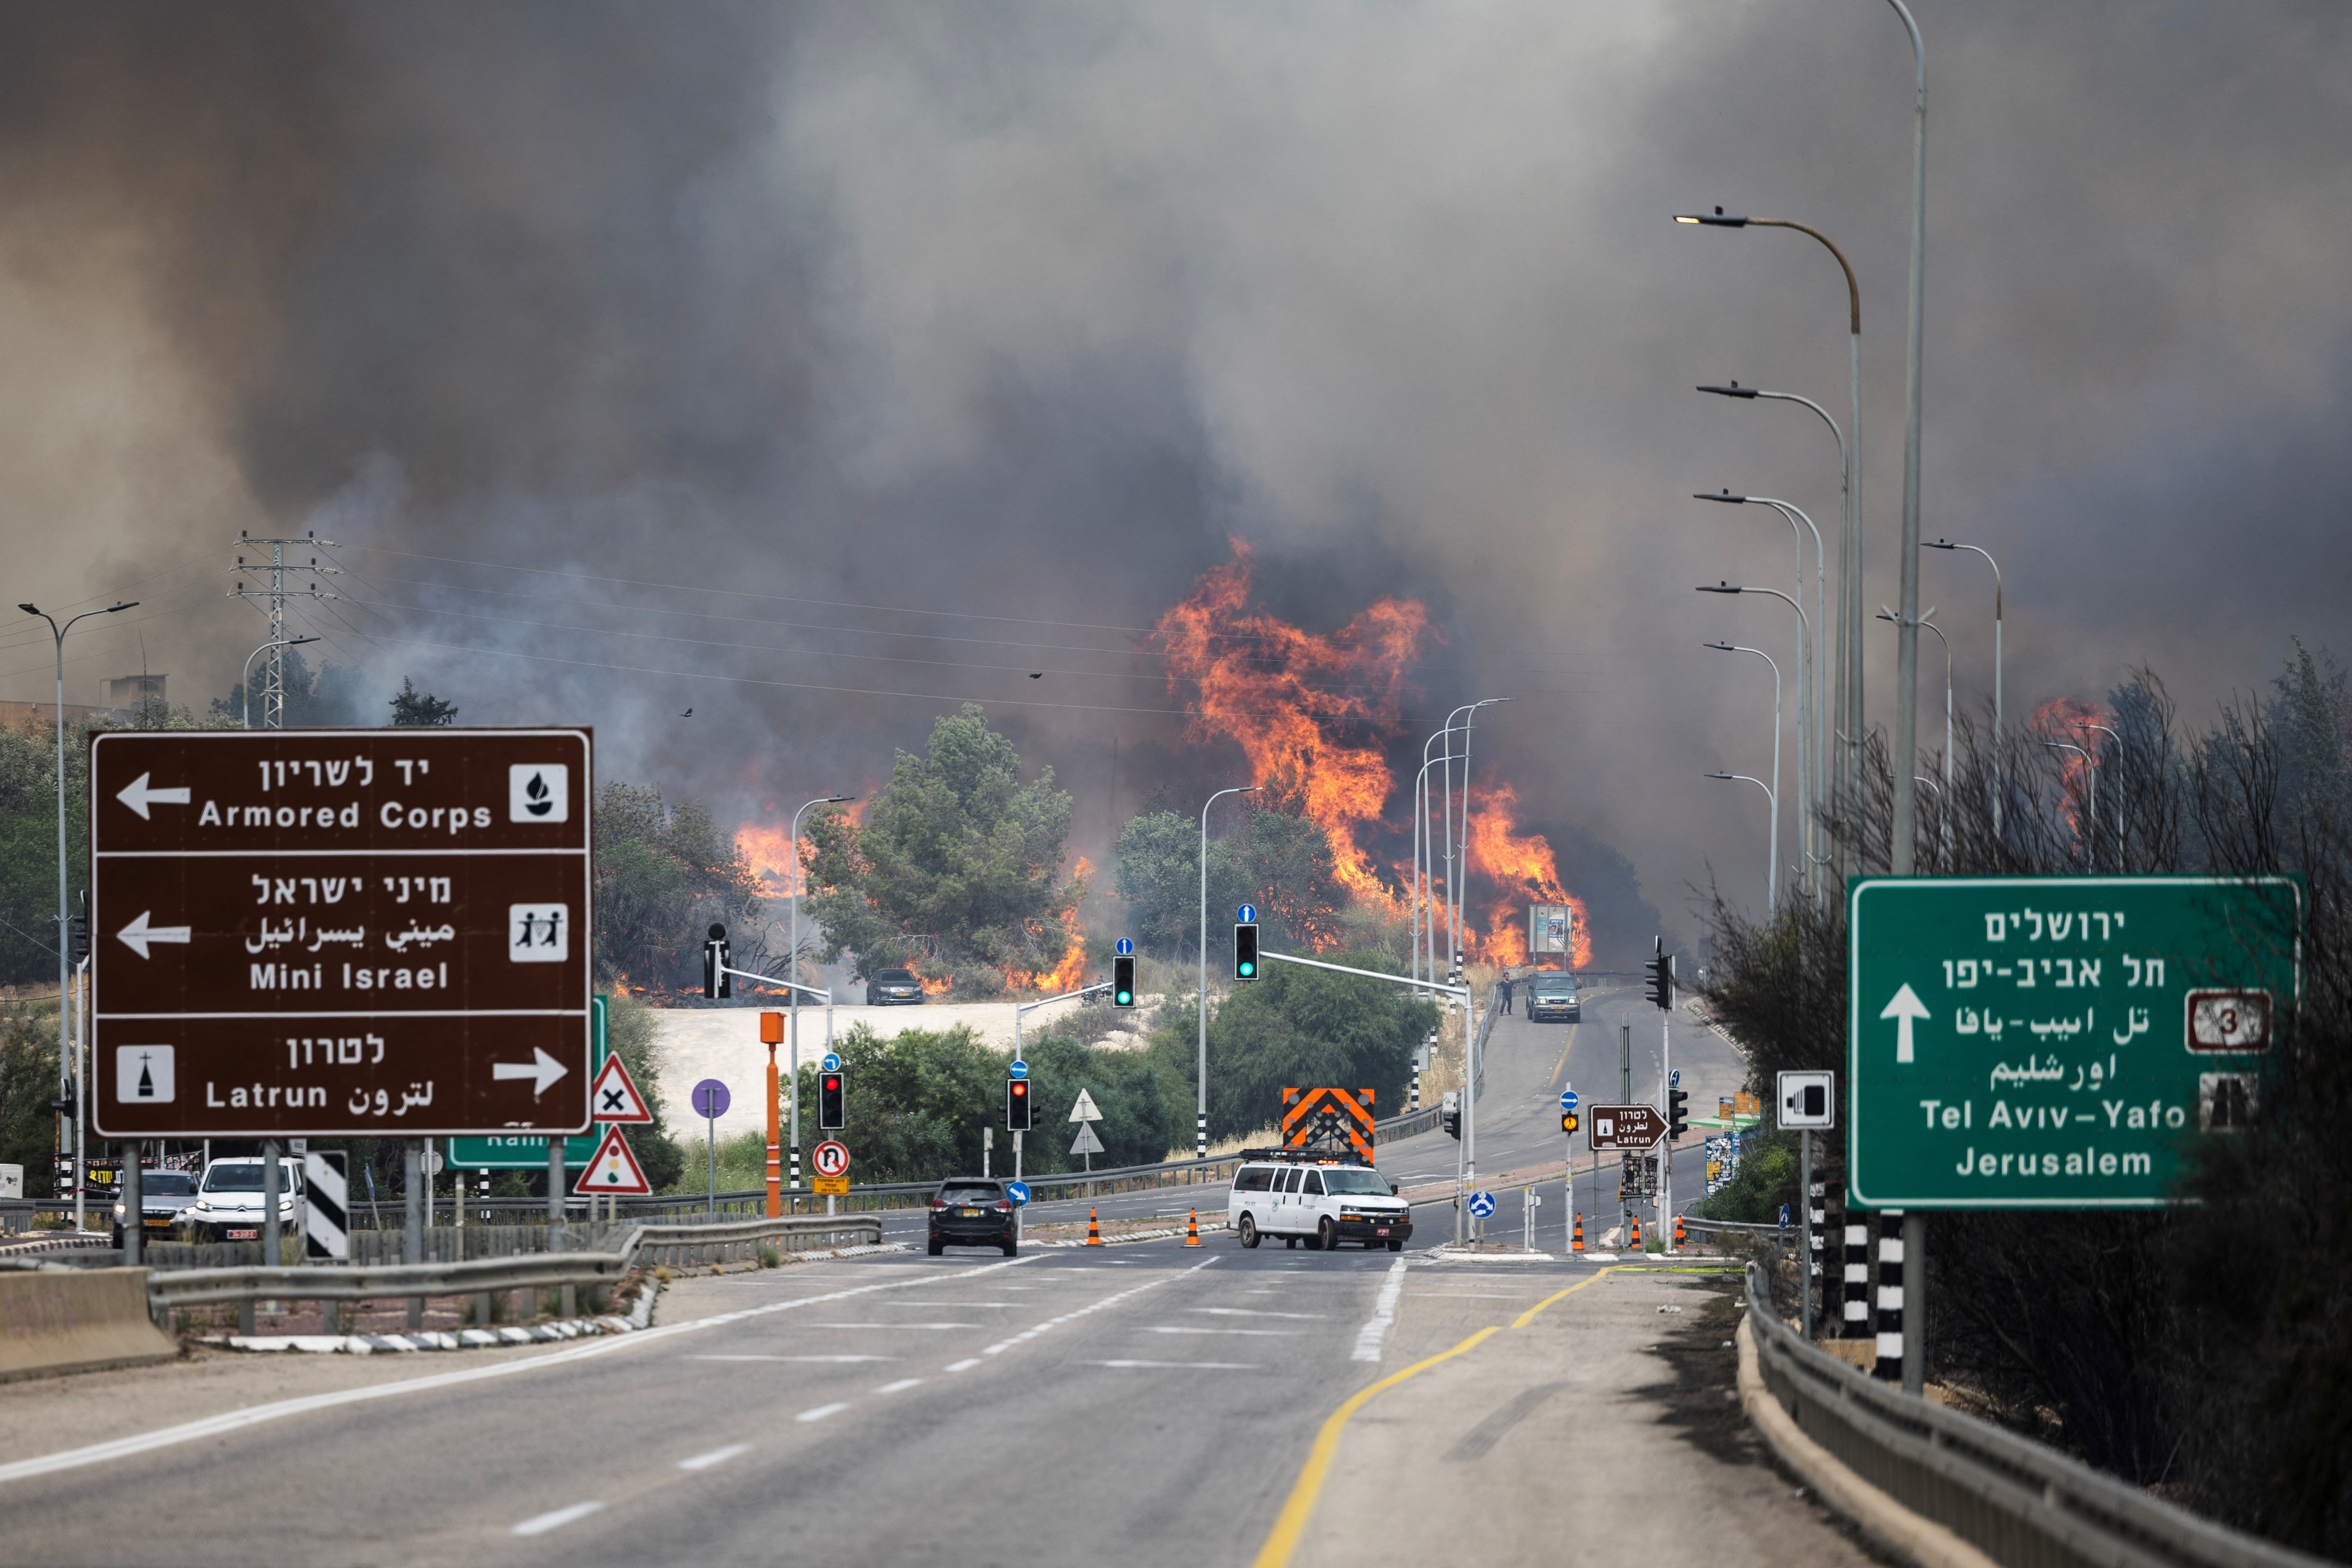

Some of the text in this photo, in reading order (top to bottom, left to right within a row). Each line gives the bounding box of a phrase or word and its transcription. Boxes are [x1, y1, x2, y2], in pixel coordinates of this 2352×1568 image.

[259, 755, 429, 791] יד לשריון
[199, 800, 492, 835] Armored Corps
[252, 874, 451, 905] מיני ישראל
[245, 916, 456, 954] ميني يسرائيل
[1985, 907, 2125, 942] ירושלים
[250, 962, 448, 989] Mini Israel
[2122, 954, 2165, 987] תל
[2113, 1006, 2150, 1045] تل
[2220, 1008, 2238, 1035] 3
[286, 1033, 385, 1069] לטרון
[1990, 1053, 2116, 1093] اورشليم
[207, 1081, 326, 1108] Latrun
[348, 1080, 434, 1116] لترون
[1618, 1122, 1648, 1133] لطرون
[1619, 1110, 1647, 1121] לטרון
[1920, 1100, 1971, 1129] Tel
[1617, 1135, 1651, 1144] Latrun
[1955, 1147, 2151, 1176] Jerusalem
